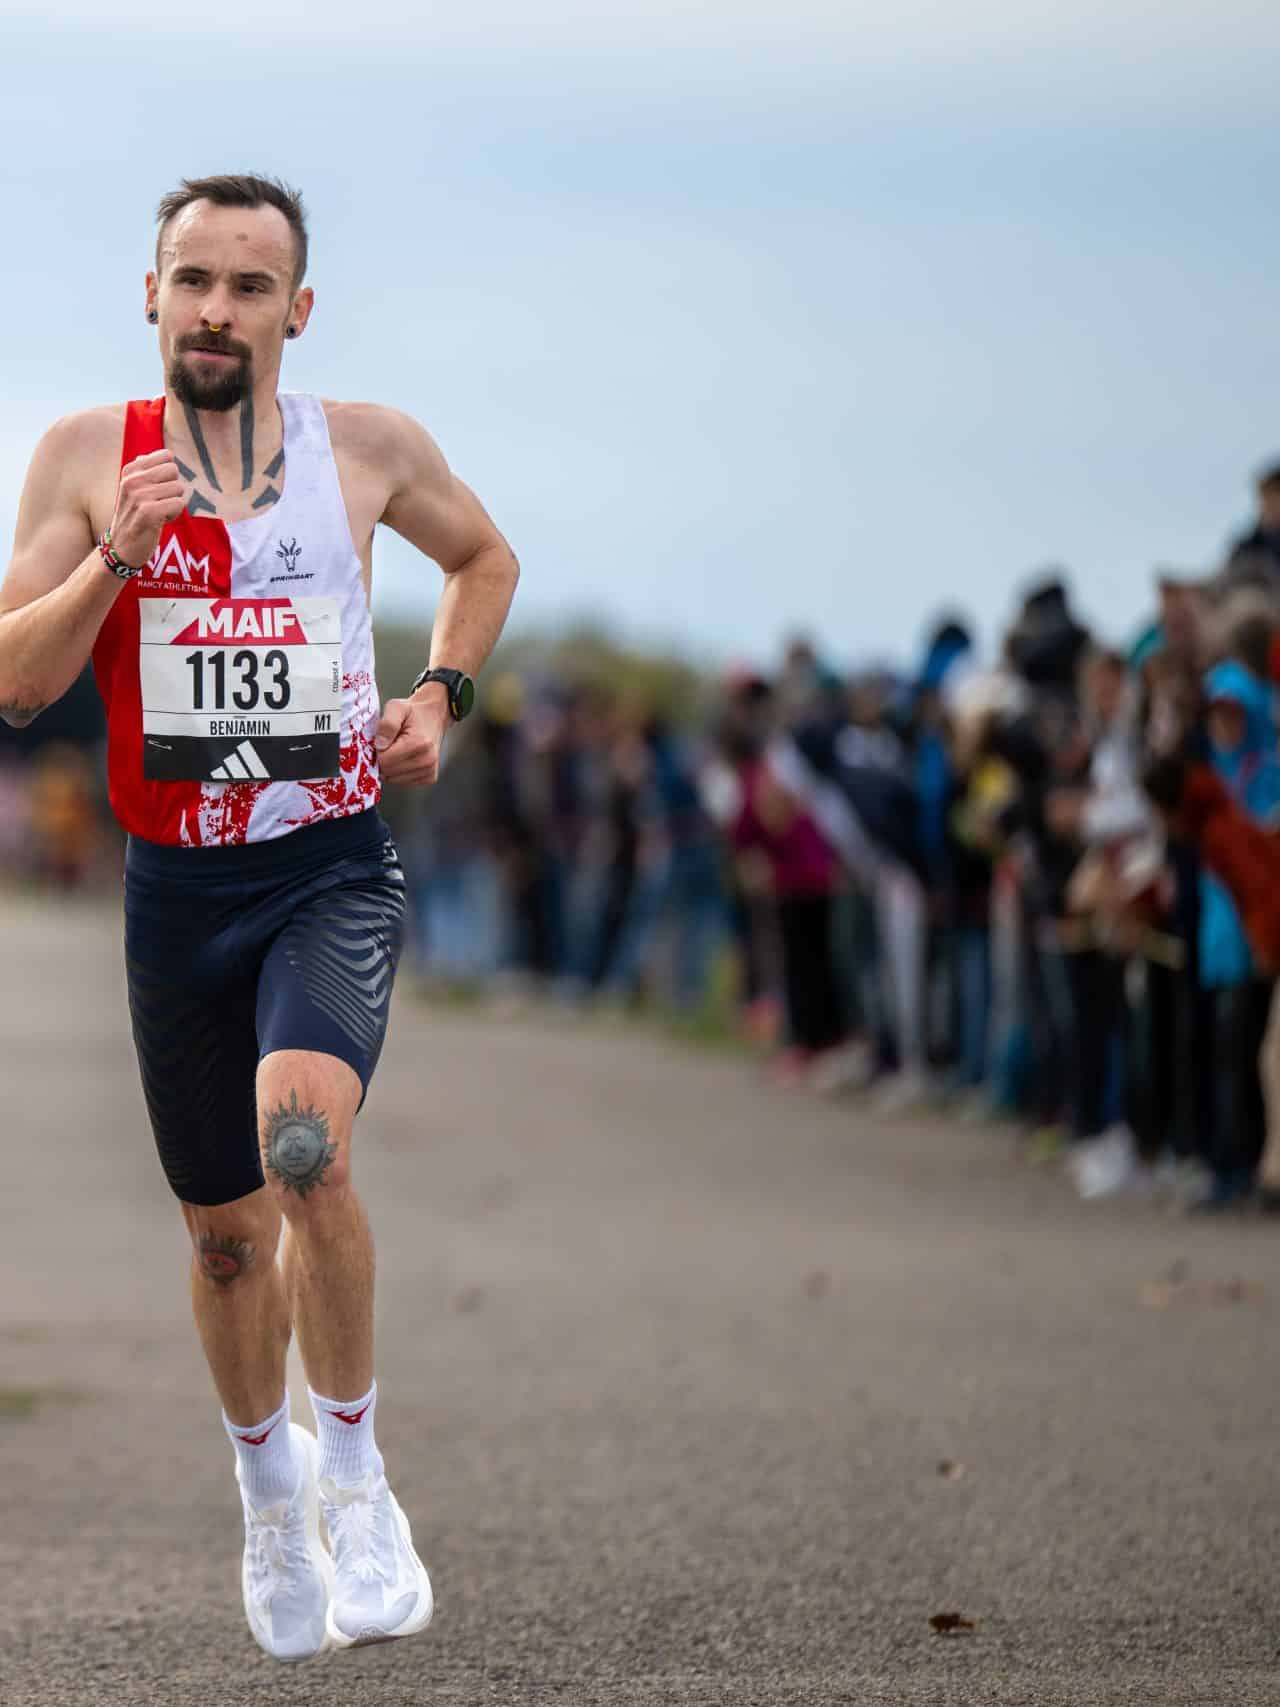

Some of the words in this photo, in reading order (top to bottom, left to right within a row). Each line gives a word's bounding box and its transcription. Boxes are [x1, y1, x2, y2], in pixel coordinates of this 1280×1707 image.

[137, 580, 163, 590] NANCY
[198, 606, 296, 638] MAIF
[186, 649, 291, 711] 1133
[209, 720, 271, 736] BENJAMIN
[314, 714, 331, 732] M1
